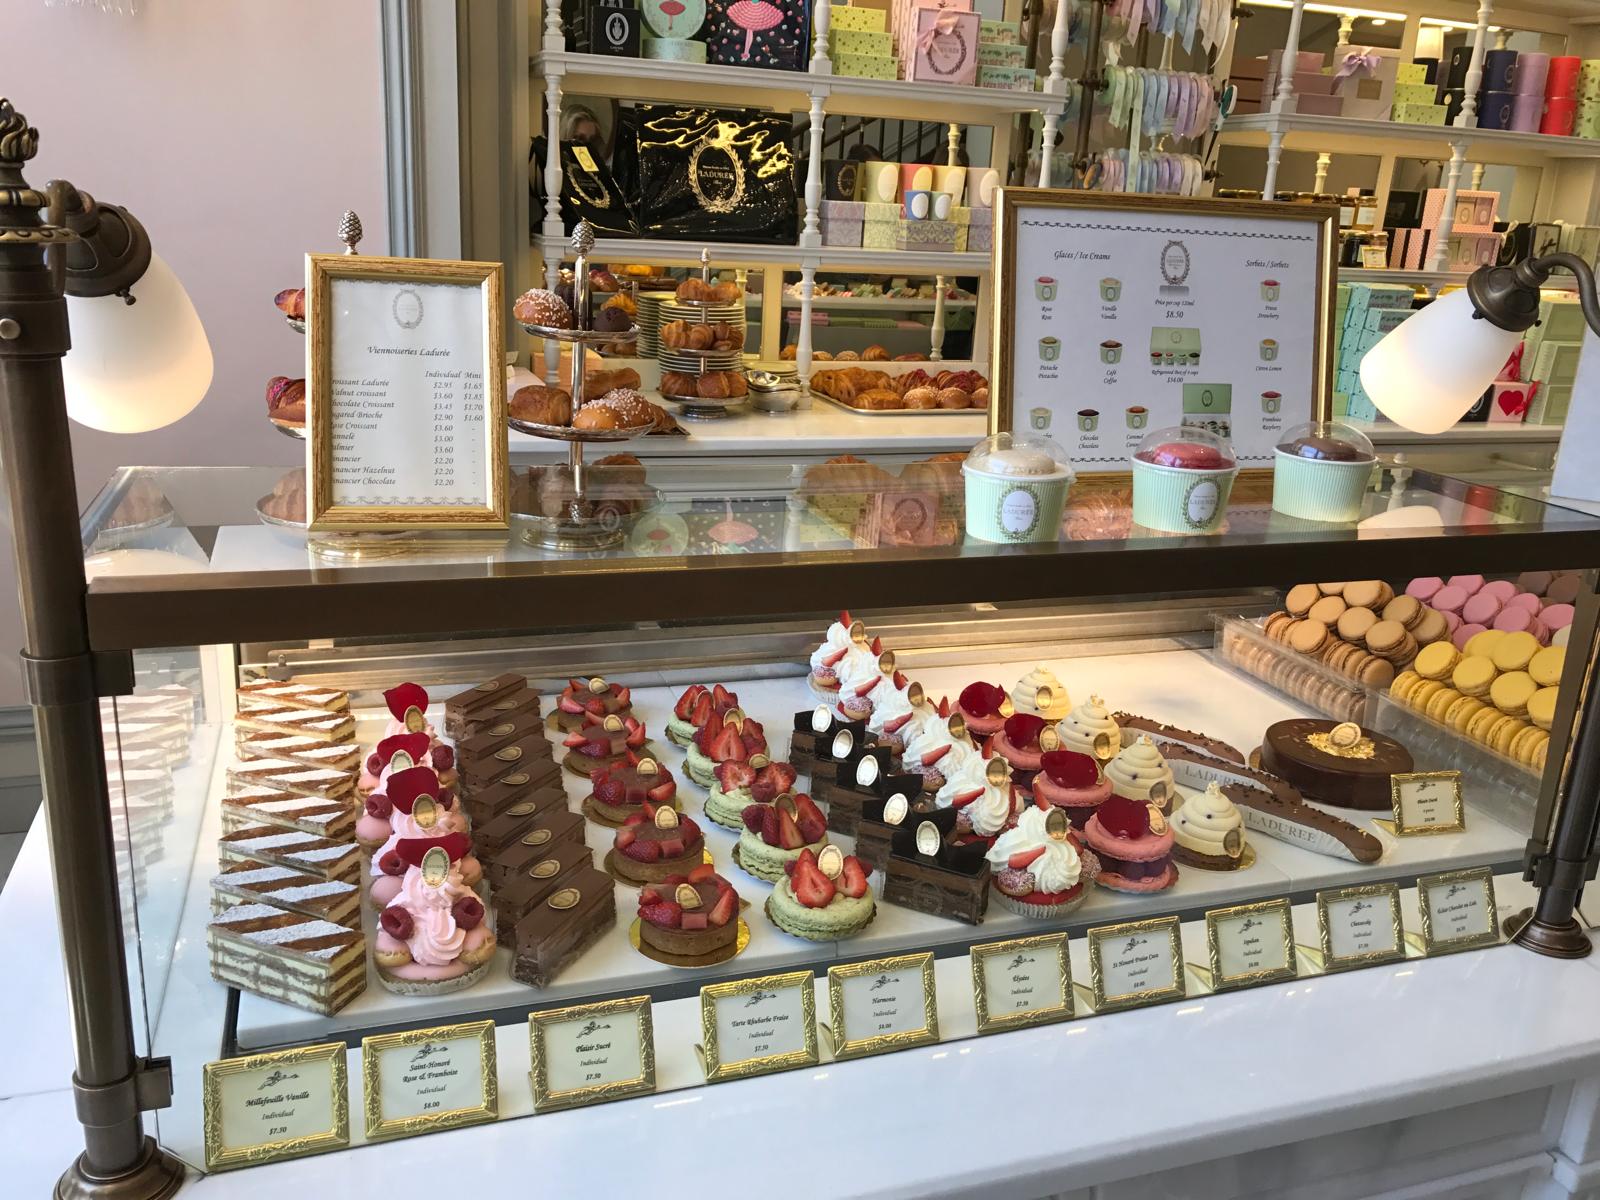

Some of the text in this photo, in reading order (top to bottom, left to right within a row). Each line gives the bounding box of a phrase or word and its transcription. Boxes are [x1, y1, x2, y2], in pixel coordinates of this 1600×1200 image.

[1054, 250, 1073, 260] Glaces
[1246, 260, 1265, 268] Sorbets
[368, 346, 450, 357] Viennoiseries Ladurée
[425, 370, 462, 379] Individual
[332, 400, 361, 408] hocolate
[362, 401, 394, 409] Croissant
[346, 422, 378, 430] Croissant
[332, 443, 454, 454] almier $3.60
[362, 466, 396, 474] Hazelnut
[362, 477, 396, 486] Chocolate
[434, 479, 454, 487] $2.20
[1010, 986, 1034, 996] Individual
[872, 1008, 898, 1018] Individual
[748, 1029, 775, 1039] Individual
[576, 1044, 594, 1053] Plaisir
[754, 1044, 769, 1052] $7.50
[409, 1058, 451, 1072] Saint-Honoré
[580, 1057, 608, 1067] Individual
[402, 1069, 458, 1083] Rose & Framboise
[416, 1084, 448, 1096] Individual
[246, 1090, 310, 1108] Millefeuille Vanille
[424, 1100, 440, 1110] $8.00
[262, 1108, 295, 1120] Individual
[269, 1126, 288, 1136] $7.50
